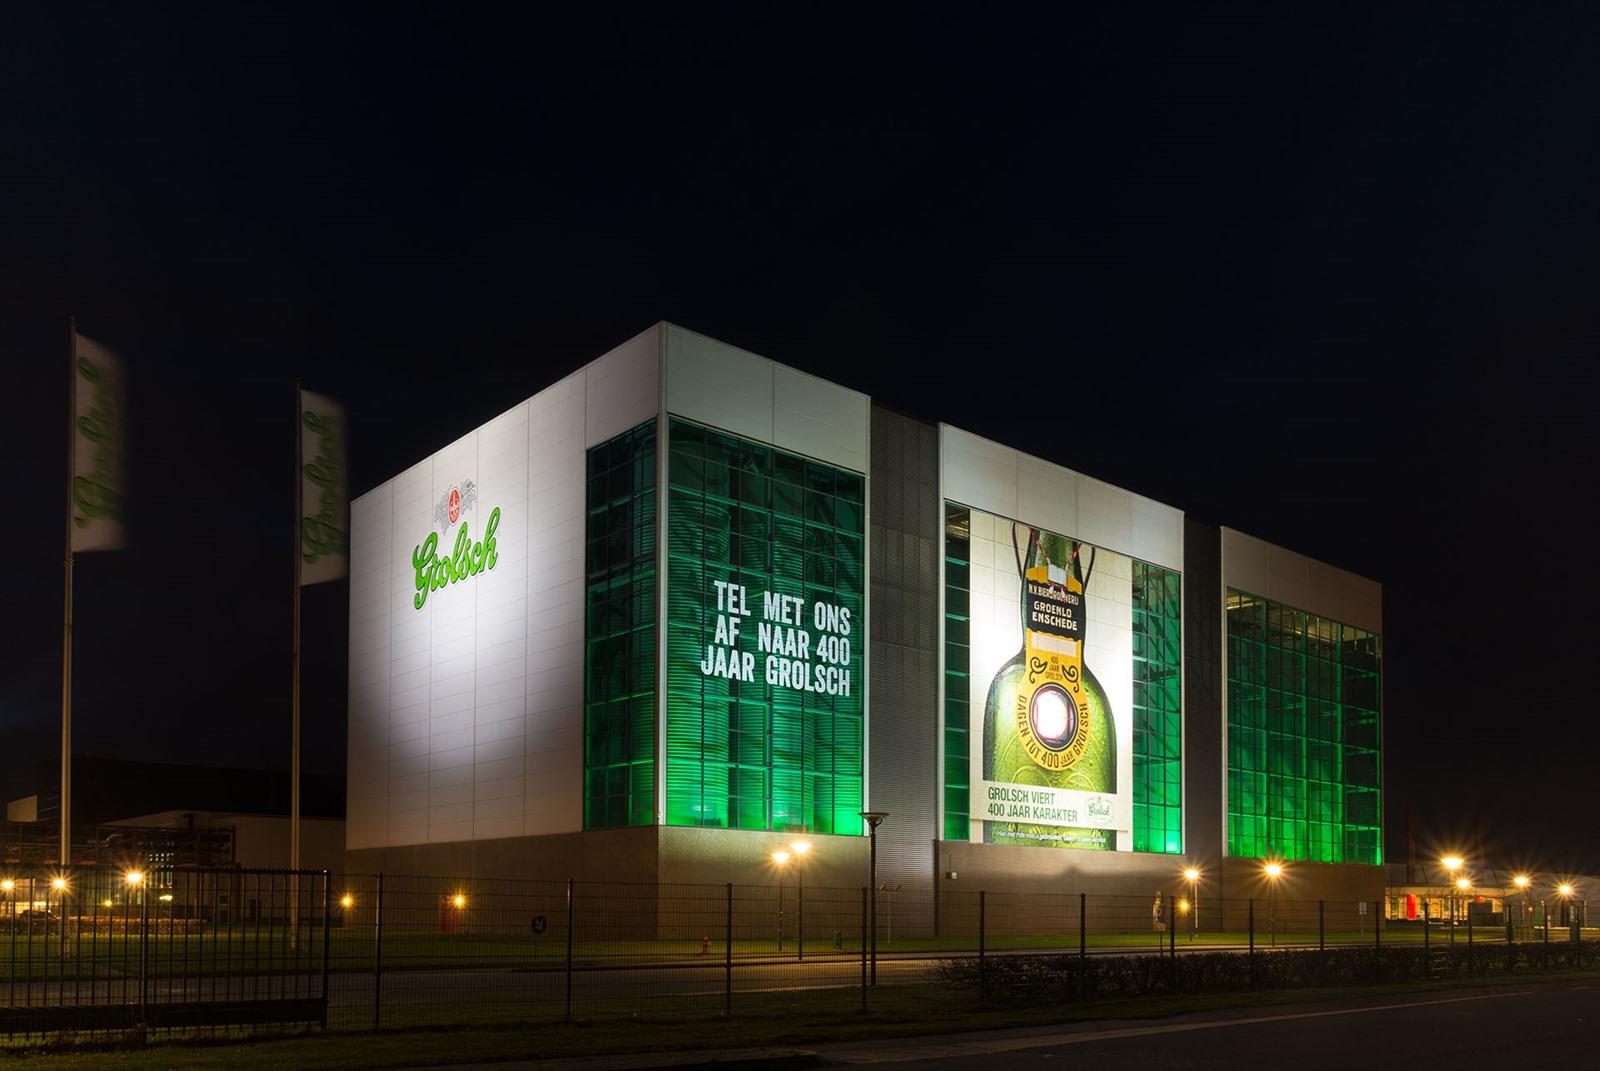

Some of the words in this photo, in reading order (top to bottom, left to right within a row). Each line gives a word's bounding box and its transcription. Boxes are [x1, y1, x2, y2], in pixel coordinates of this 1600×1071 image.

[412, 506, 500, 610] Grolsch
[714, 580, 750, 616] TEL
[764, 591, 804, 626] MET
[814, 601, 850, 635] ONS
[1032, 612, 1077, 630] ENSCHEDE
[1034, 601, 1072, 619] GROENLO
[714, 614, 741, 646] AF
[758, 622, 810, 659] NAAR
[816, 634, 850, 666] 400
[701, 645, 755, 682] JAAR
[766, 655, 850, 697] GROLSCH
[1017, 695, 1030, 738] DAGEN
[1025, 739, 1042, 759] TOT
[1041, 751, 1059, 768] 400
[1073, 703, 1088, 756] GROLSCH
[988, 786, 1029, 803] GROLSCH
[1031, 791, 1055, 805] VIERT
[988, 803, 1004, 816] 400
[1007, 805, 1031, 818] JAAR
[1033, 807, 1078, 822] KARAKTER
